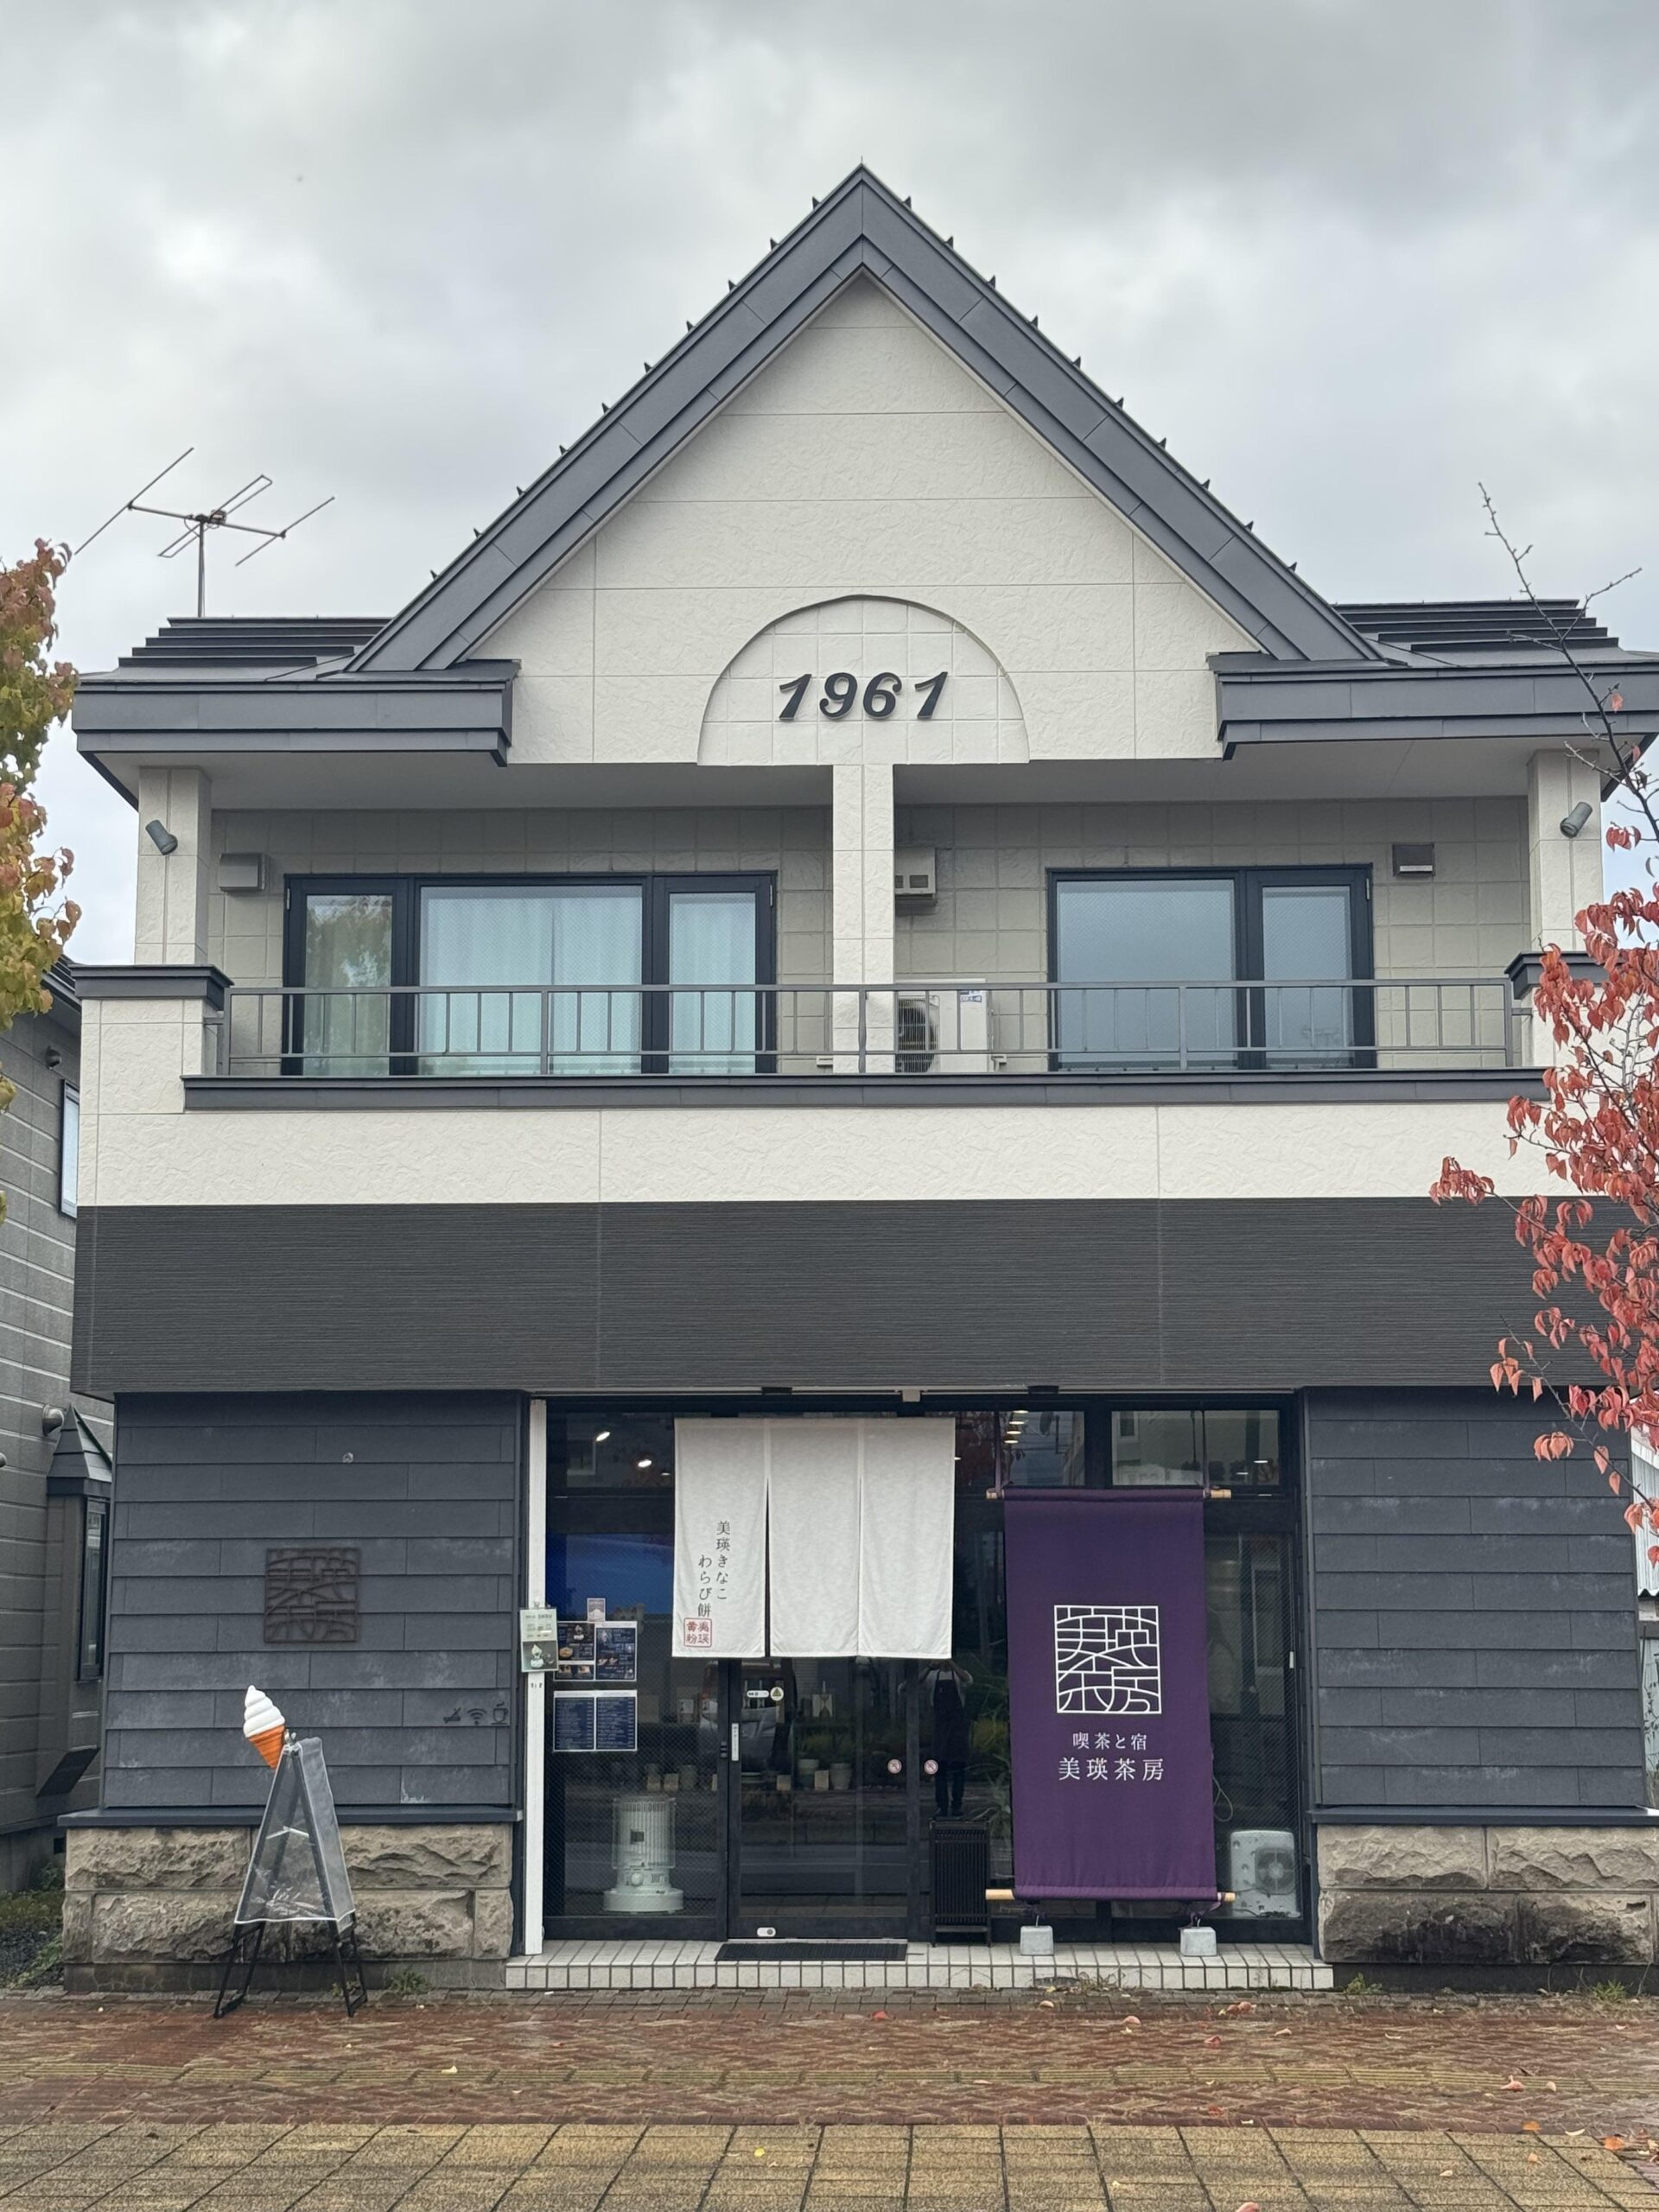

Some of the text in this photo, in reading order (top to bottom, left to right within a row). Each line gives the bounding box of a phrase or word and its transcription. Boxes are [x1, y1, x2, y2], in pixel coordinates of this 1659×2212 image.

[779, 671, 949, 721] 1961
[715, 1520, 731, 1600] 美瑛きなこ
[697, 1554, 712, 1618] わらび餅
[1072, 1732, 1147, 1751] 喫茶と宿
[1058, 1757, 1165, 1782] 美瑛茶房
